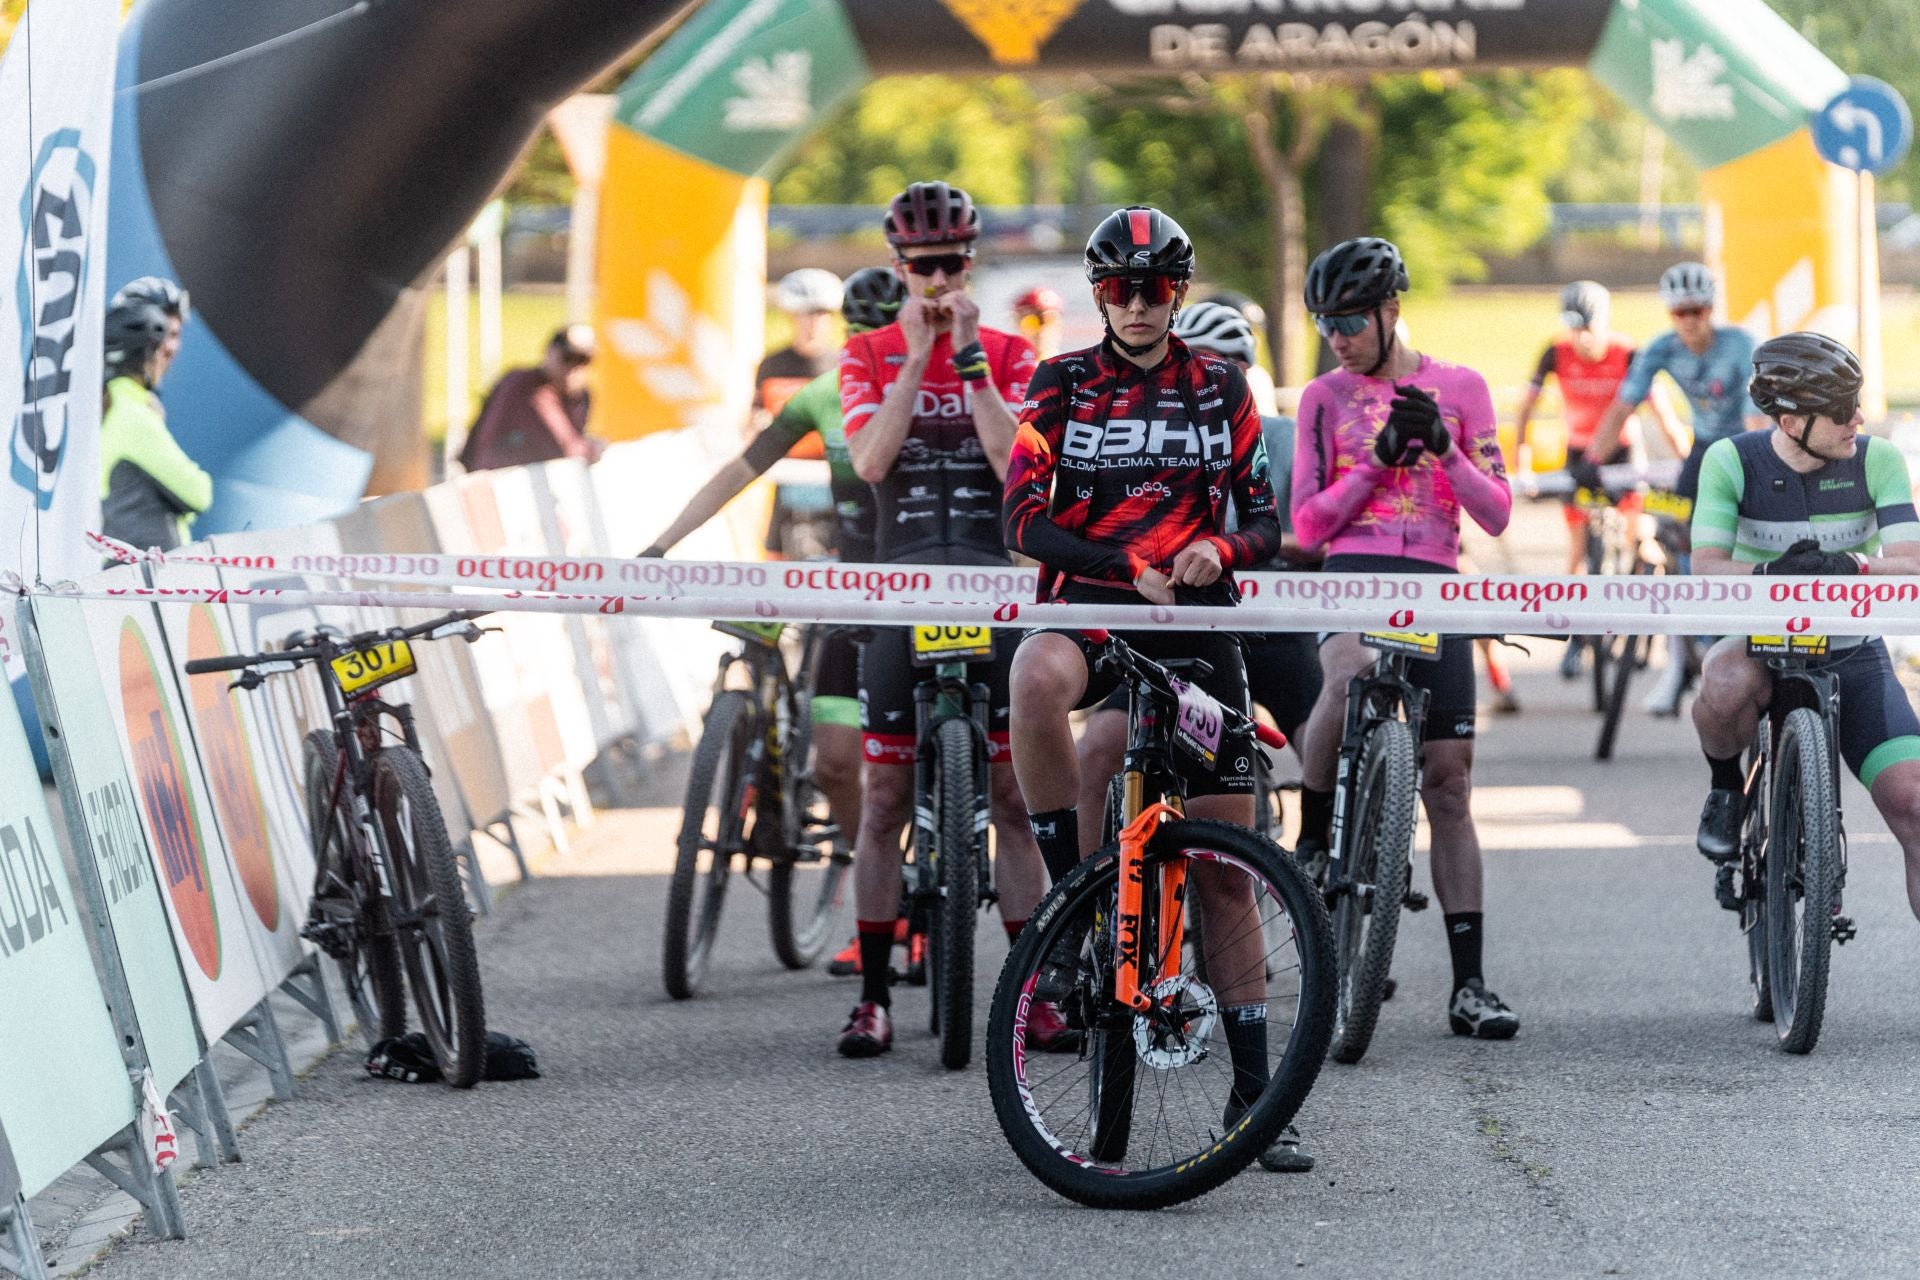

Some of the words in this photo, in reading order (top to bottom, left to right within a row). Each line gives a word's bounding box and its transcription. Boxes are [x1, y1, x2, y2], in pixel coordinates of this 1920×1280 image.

[1150, 23, 1231, 67] DE
[1235, 12, 1477, 67] ARAGÓN
[21, 183, 83, 475] CRUZ
[1098, 456, 1154, 468] OLOMA
[1158, 456, 1200, 468] TEAM
[456, 555, 605, 592] octagon
[784, 565, 932, 601] octagon
[1440, 577, 1588, 613] octagon
[1769, 578, 1919, 618] octagon
[0, 815, 69, 958] ODA
[1036, 891, 1068, 933] ASPEN
[1116, 913, 1140, 970] FOX
